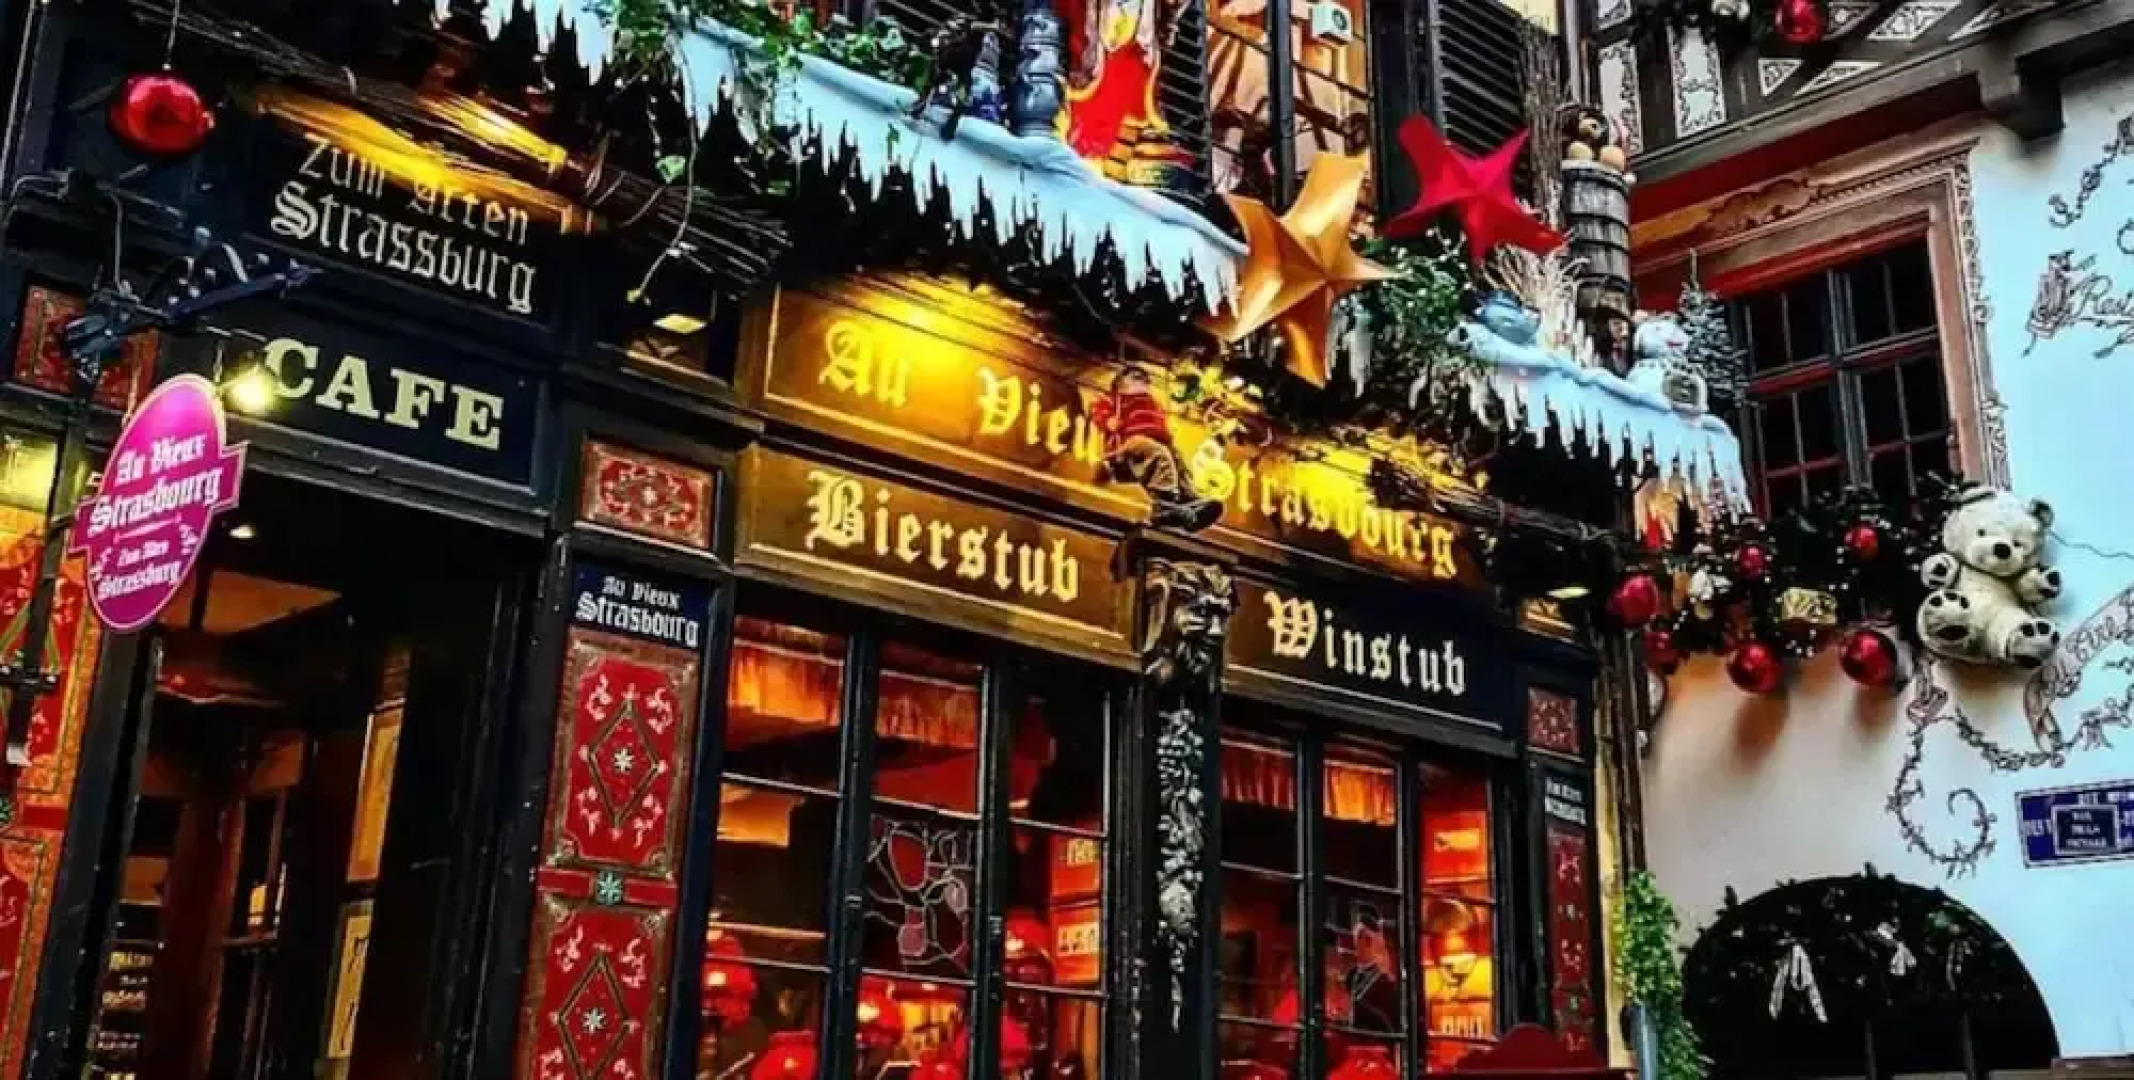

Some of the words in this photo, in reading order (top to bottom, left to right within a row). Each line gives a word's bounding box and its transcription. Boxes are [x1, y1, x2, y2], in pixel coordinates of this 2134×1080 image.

[299, 132, 385, 200] Zum
[270, 180, 537, 314] Strassburg
[263, 337, 504, 451] CAFE
[86, 467, 223, 538] Strasbourg
[818, 320, 910, 408] Au
[975, 365, 1104, 463] Vieu
[1190, 438, 1459, 580] Strasbourg
[804, 468, 1080, 604] Bierstub
[575, 590, 699, 648] Strasbourg
[1263, 589, 1467, 696] Winstub
